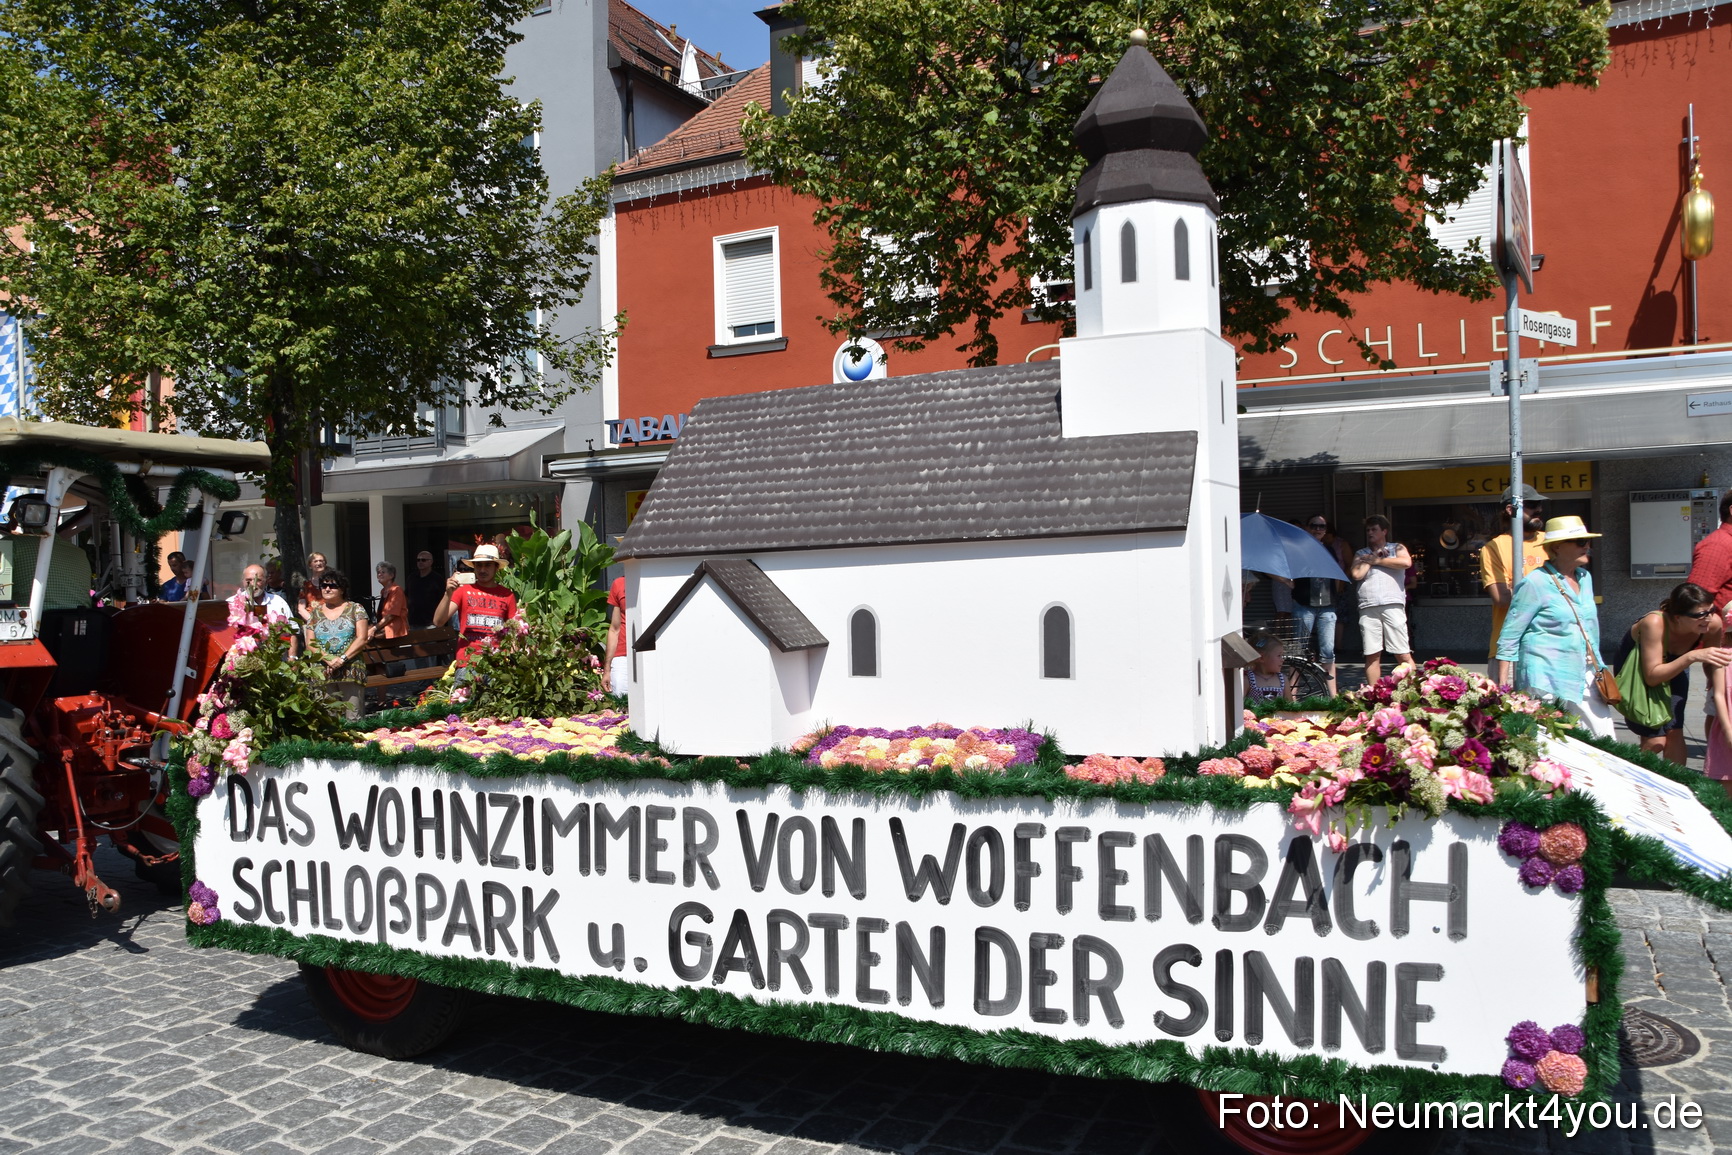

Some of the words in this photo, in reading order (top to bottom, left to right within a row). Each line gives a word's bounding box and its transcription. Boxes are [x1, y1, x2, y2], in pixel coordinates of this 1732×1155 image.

[1279, 305, 1612, 369] SCHLIEF
[1523, 314, 1572, 339] Rosengasse
[1703, 400, 1732, 408] Rathaus
[1467, 473, 1588, 493] SCHIERF
[227, 774, 316, 847] DAS
[328, 780, 721, 891] WOHNZIMMER
[736, 809, 866, 900] VON
[889, 816, 1468, 942] WOFFENBACH
[232, 857, 561, 964] SCHLOßPARK
[587, 922, 648, 972] u.
[668, 901, 946, 1009] GARTEN
[973, 925, 1125, 1029] DER
[1152, 943, 1448, 1063] SINNE
